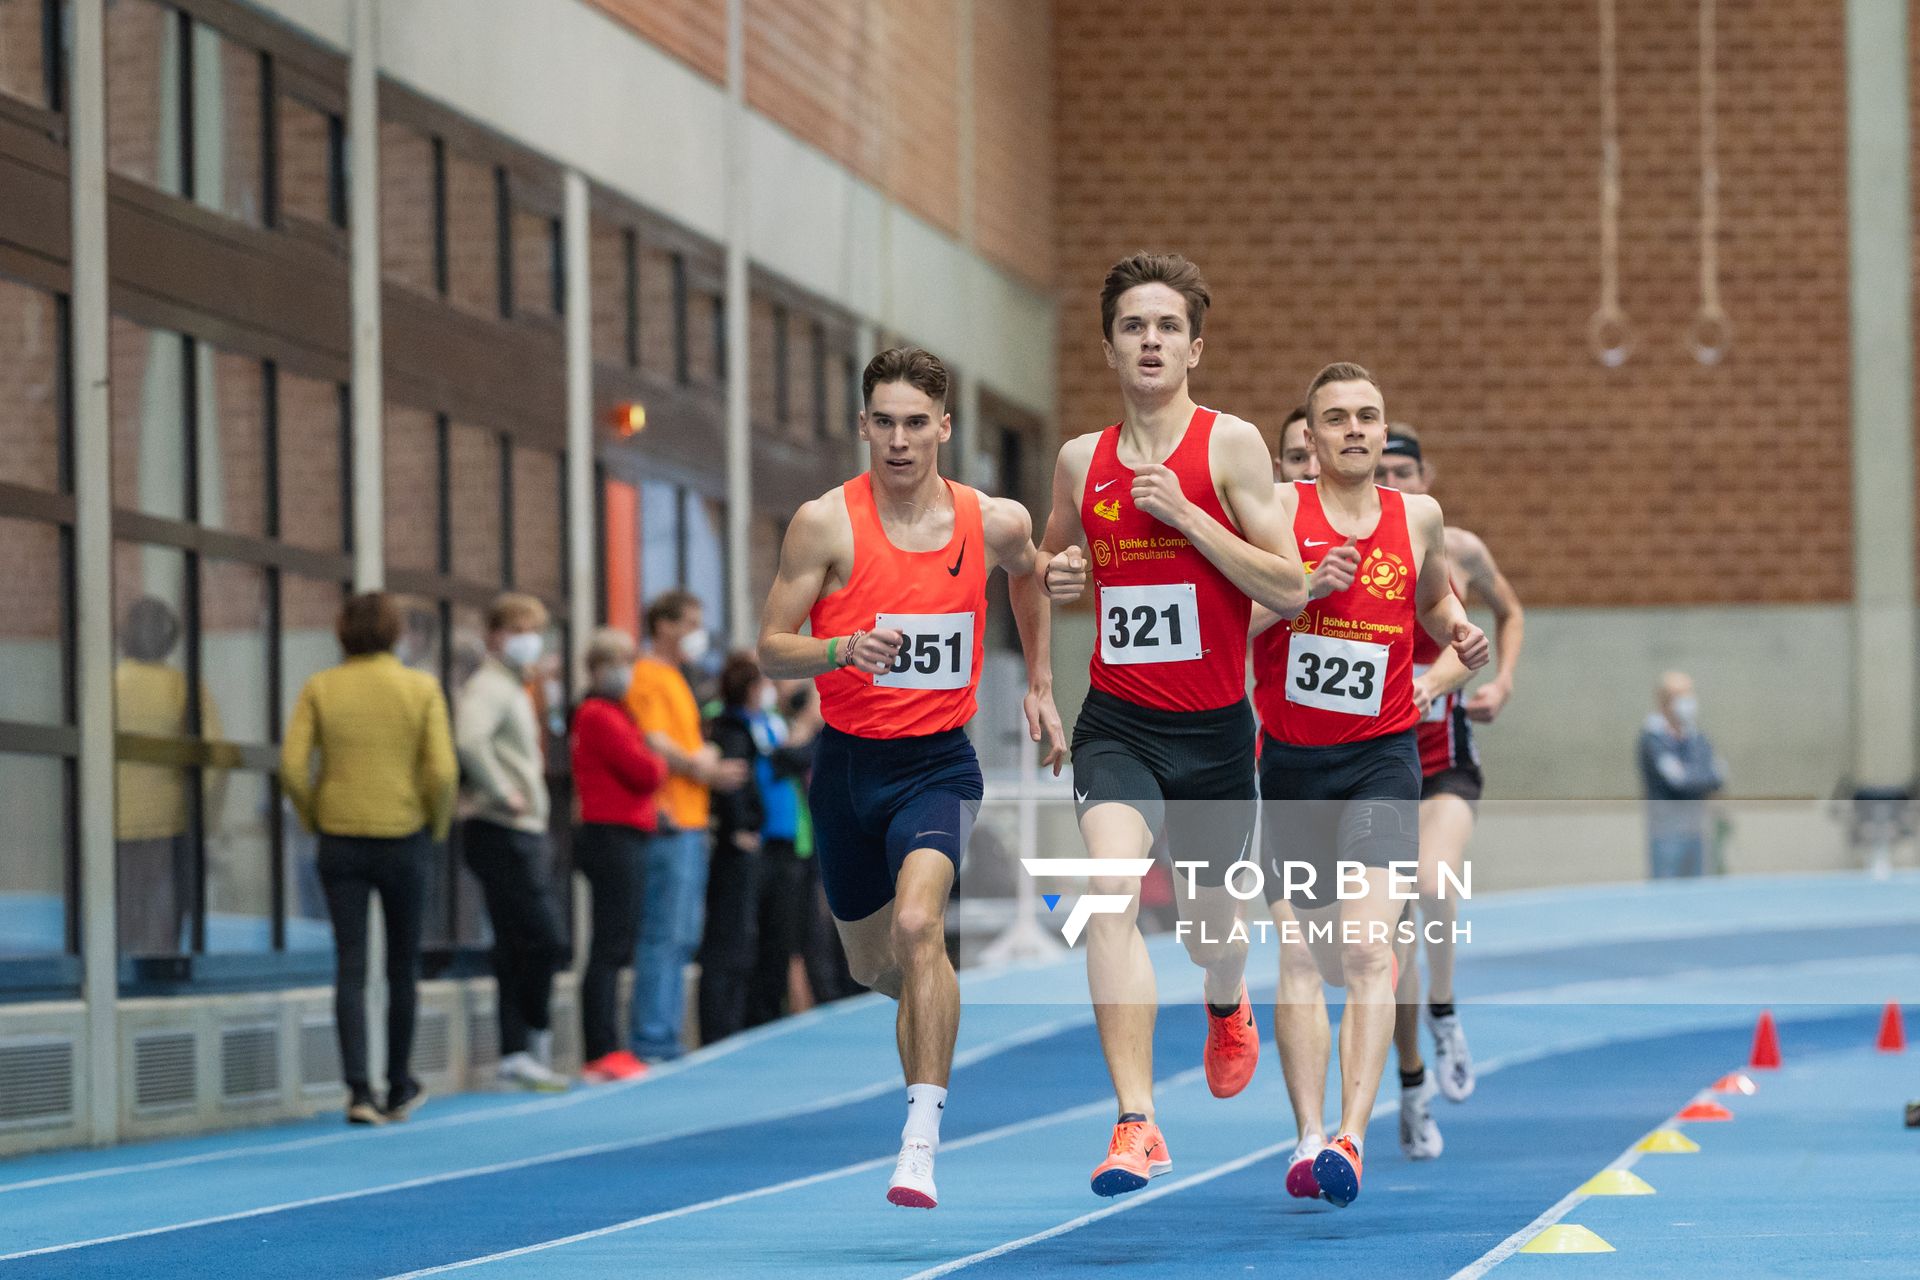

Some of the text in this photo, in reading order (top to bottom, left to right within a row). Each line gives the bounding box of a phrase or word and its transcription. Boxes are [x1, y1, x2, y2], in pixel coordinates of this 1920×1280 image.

[1119, 538, 1149, 550] Böhke
[1150, 537, 1157, 548] &
[1121, 550, 1176, 561] Consultants
[1108, 603, 1182, 649] 321
[1322, 617, 1403, 634] Böhke & Compagnie
[1321, 627, 1373, 640] Consultants
[1295, 652, 1375, 700] 323
